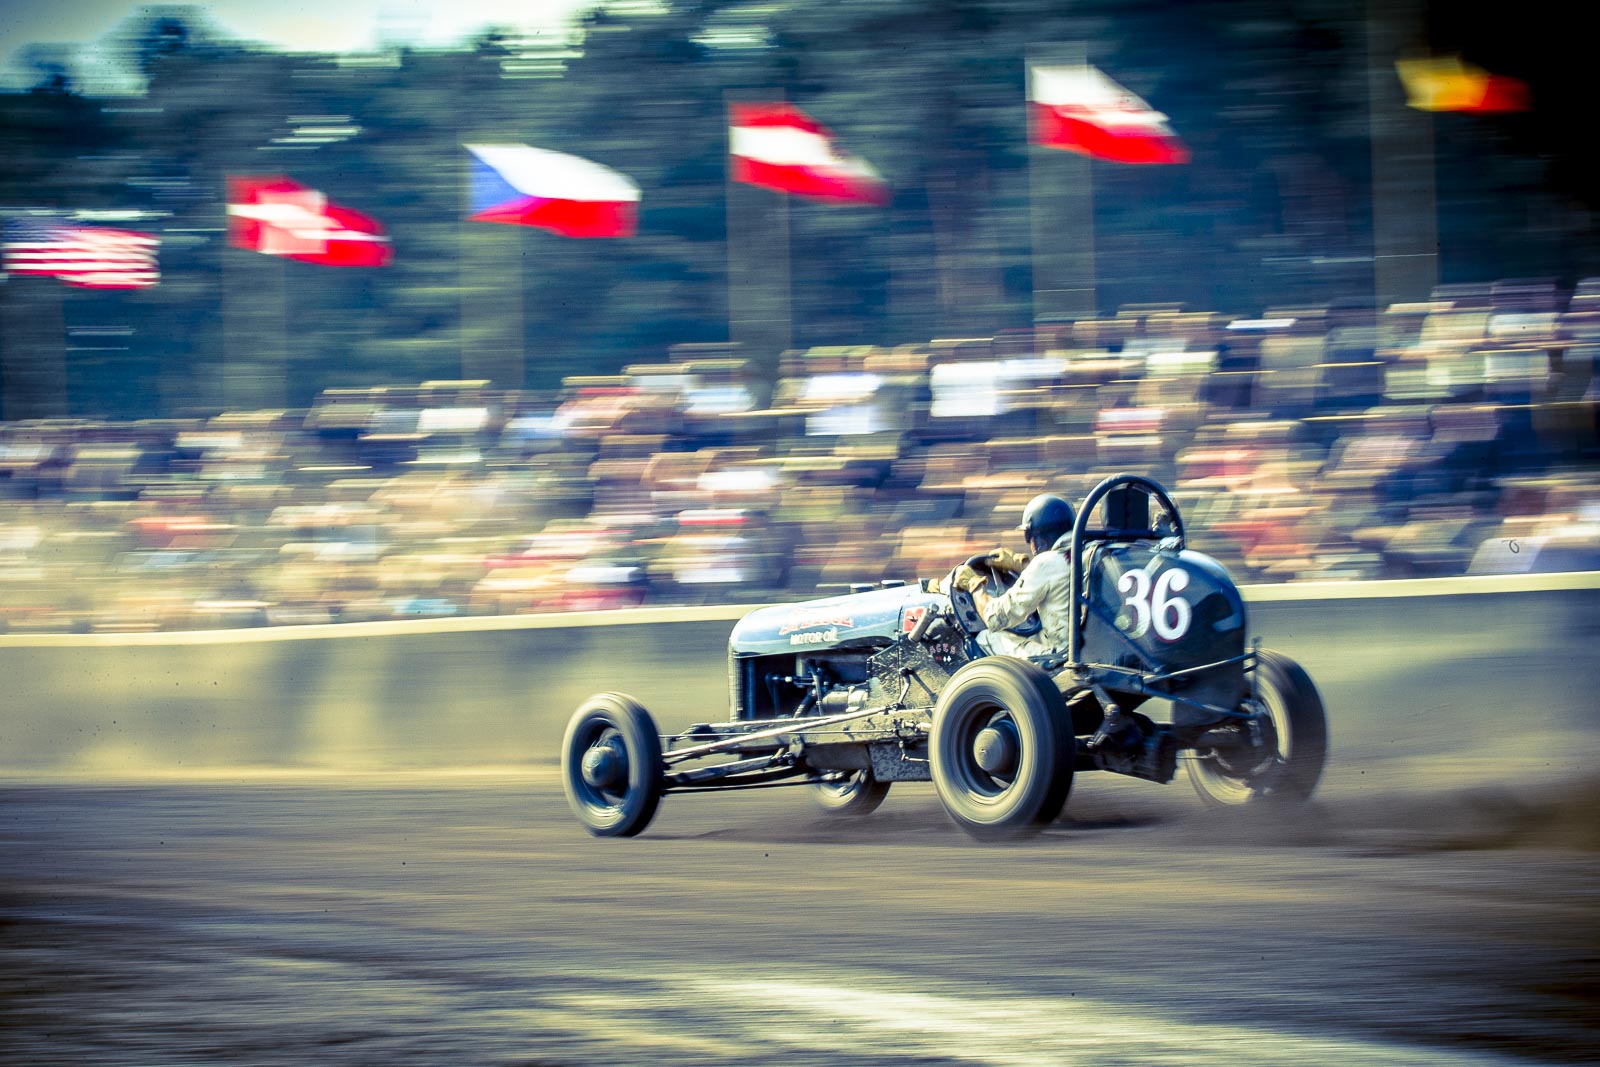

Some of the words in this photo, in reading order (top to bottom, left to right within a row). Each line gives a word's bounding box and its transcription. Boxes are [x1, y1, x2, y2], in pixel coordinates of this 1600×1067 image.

[1117, 567, 1192, 641] 36
[790, 632, 822, 645] MOTOR
[823, 629, 839, 642] OIL
